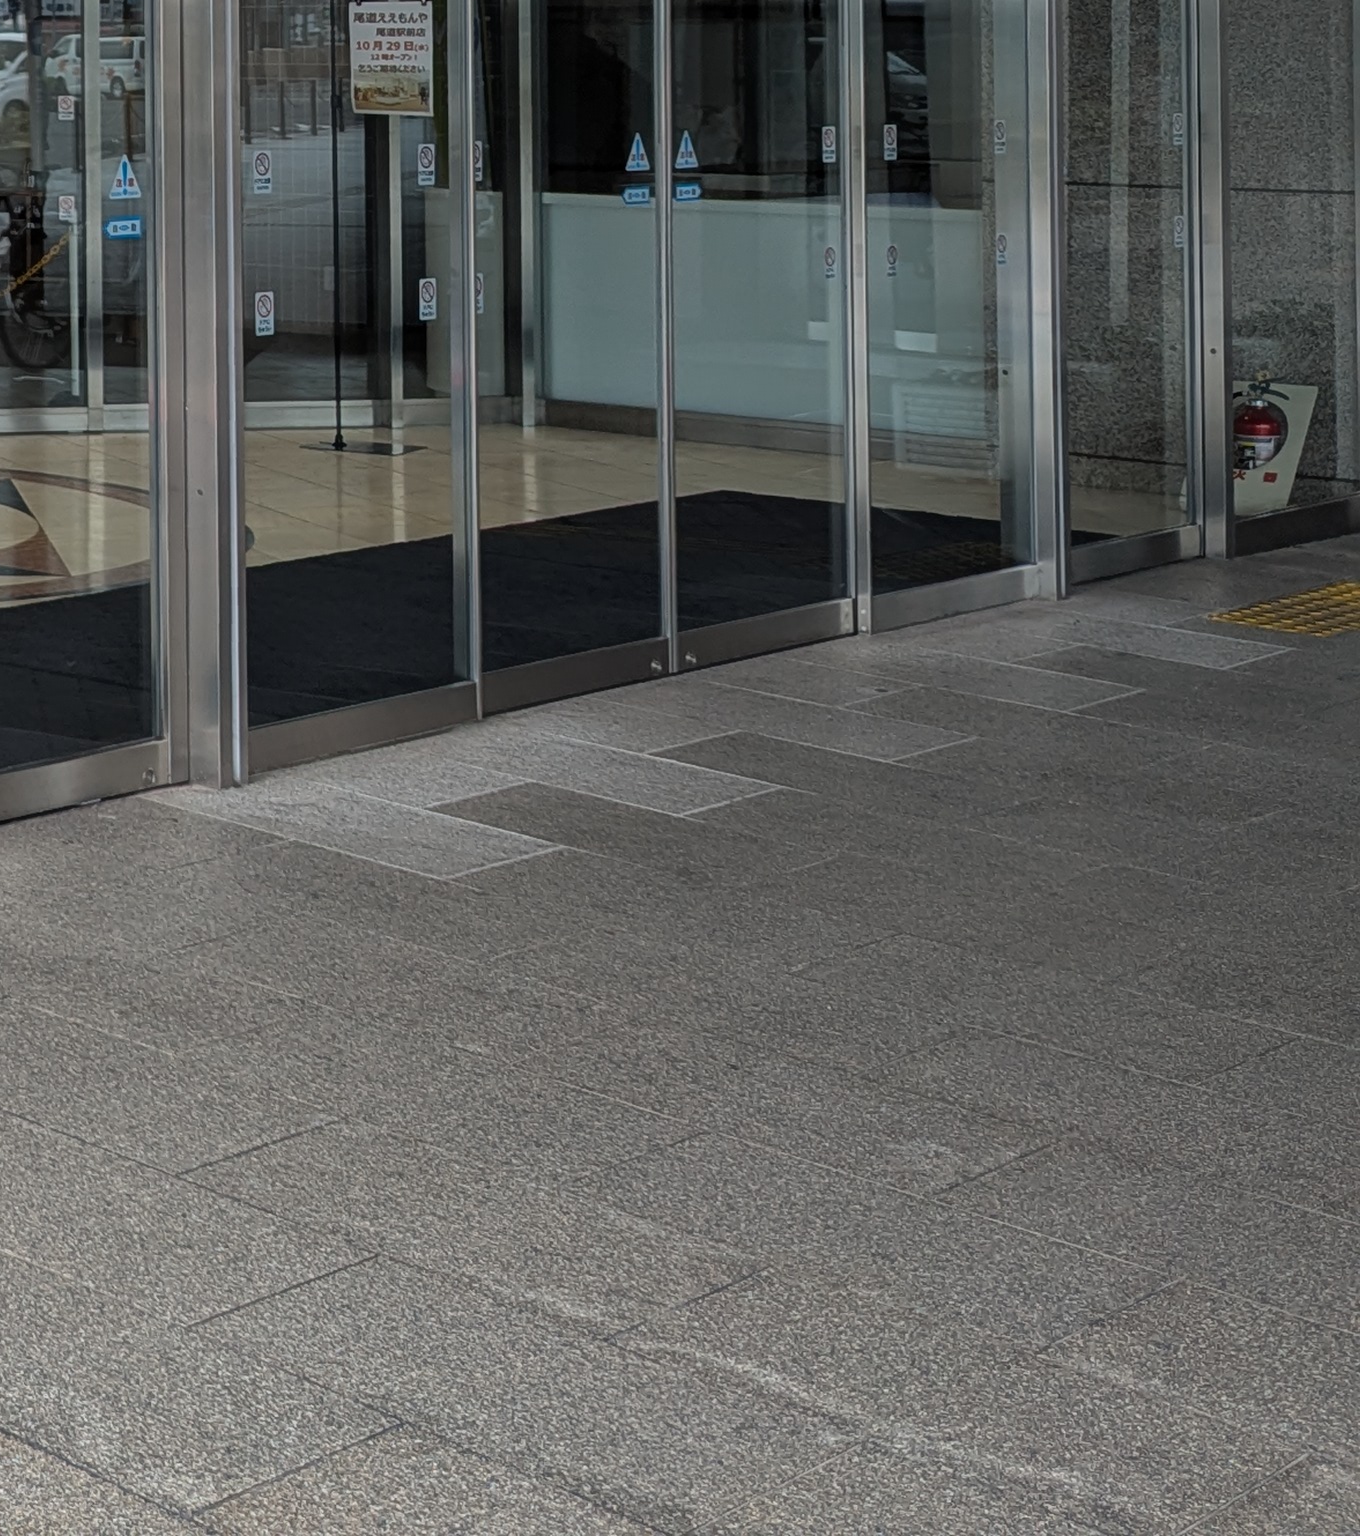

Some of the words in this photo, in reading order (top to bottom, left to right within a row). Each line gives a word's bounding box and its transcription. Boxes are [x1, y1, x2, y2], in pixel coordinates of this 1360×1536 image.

[353, 11, 428, 24] 尾道ええもんや
[376, 27, 426, 37] 尾道駅前店
